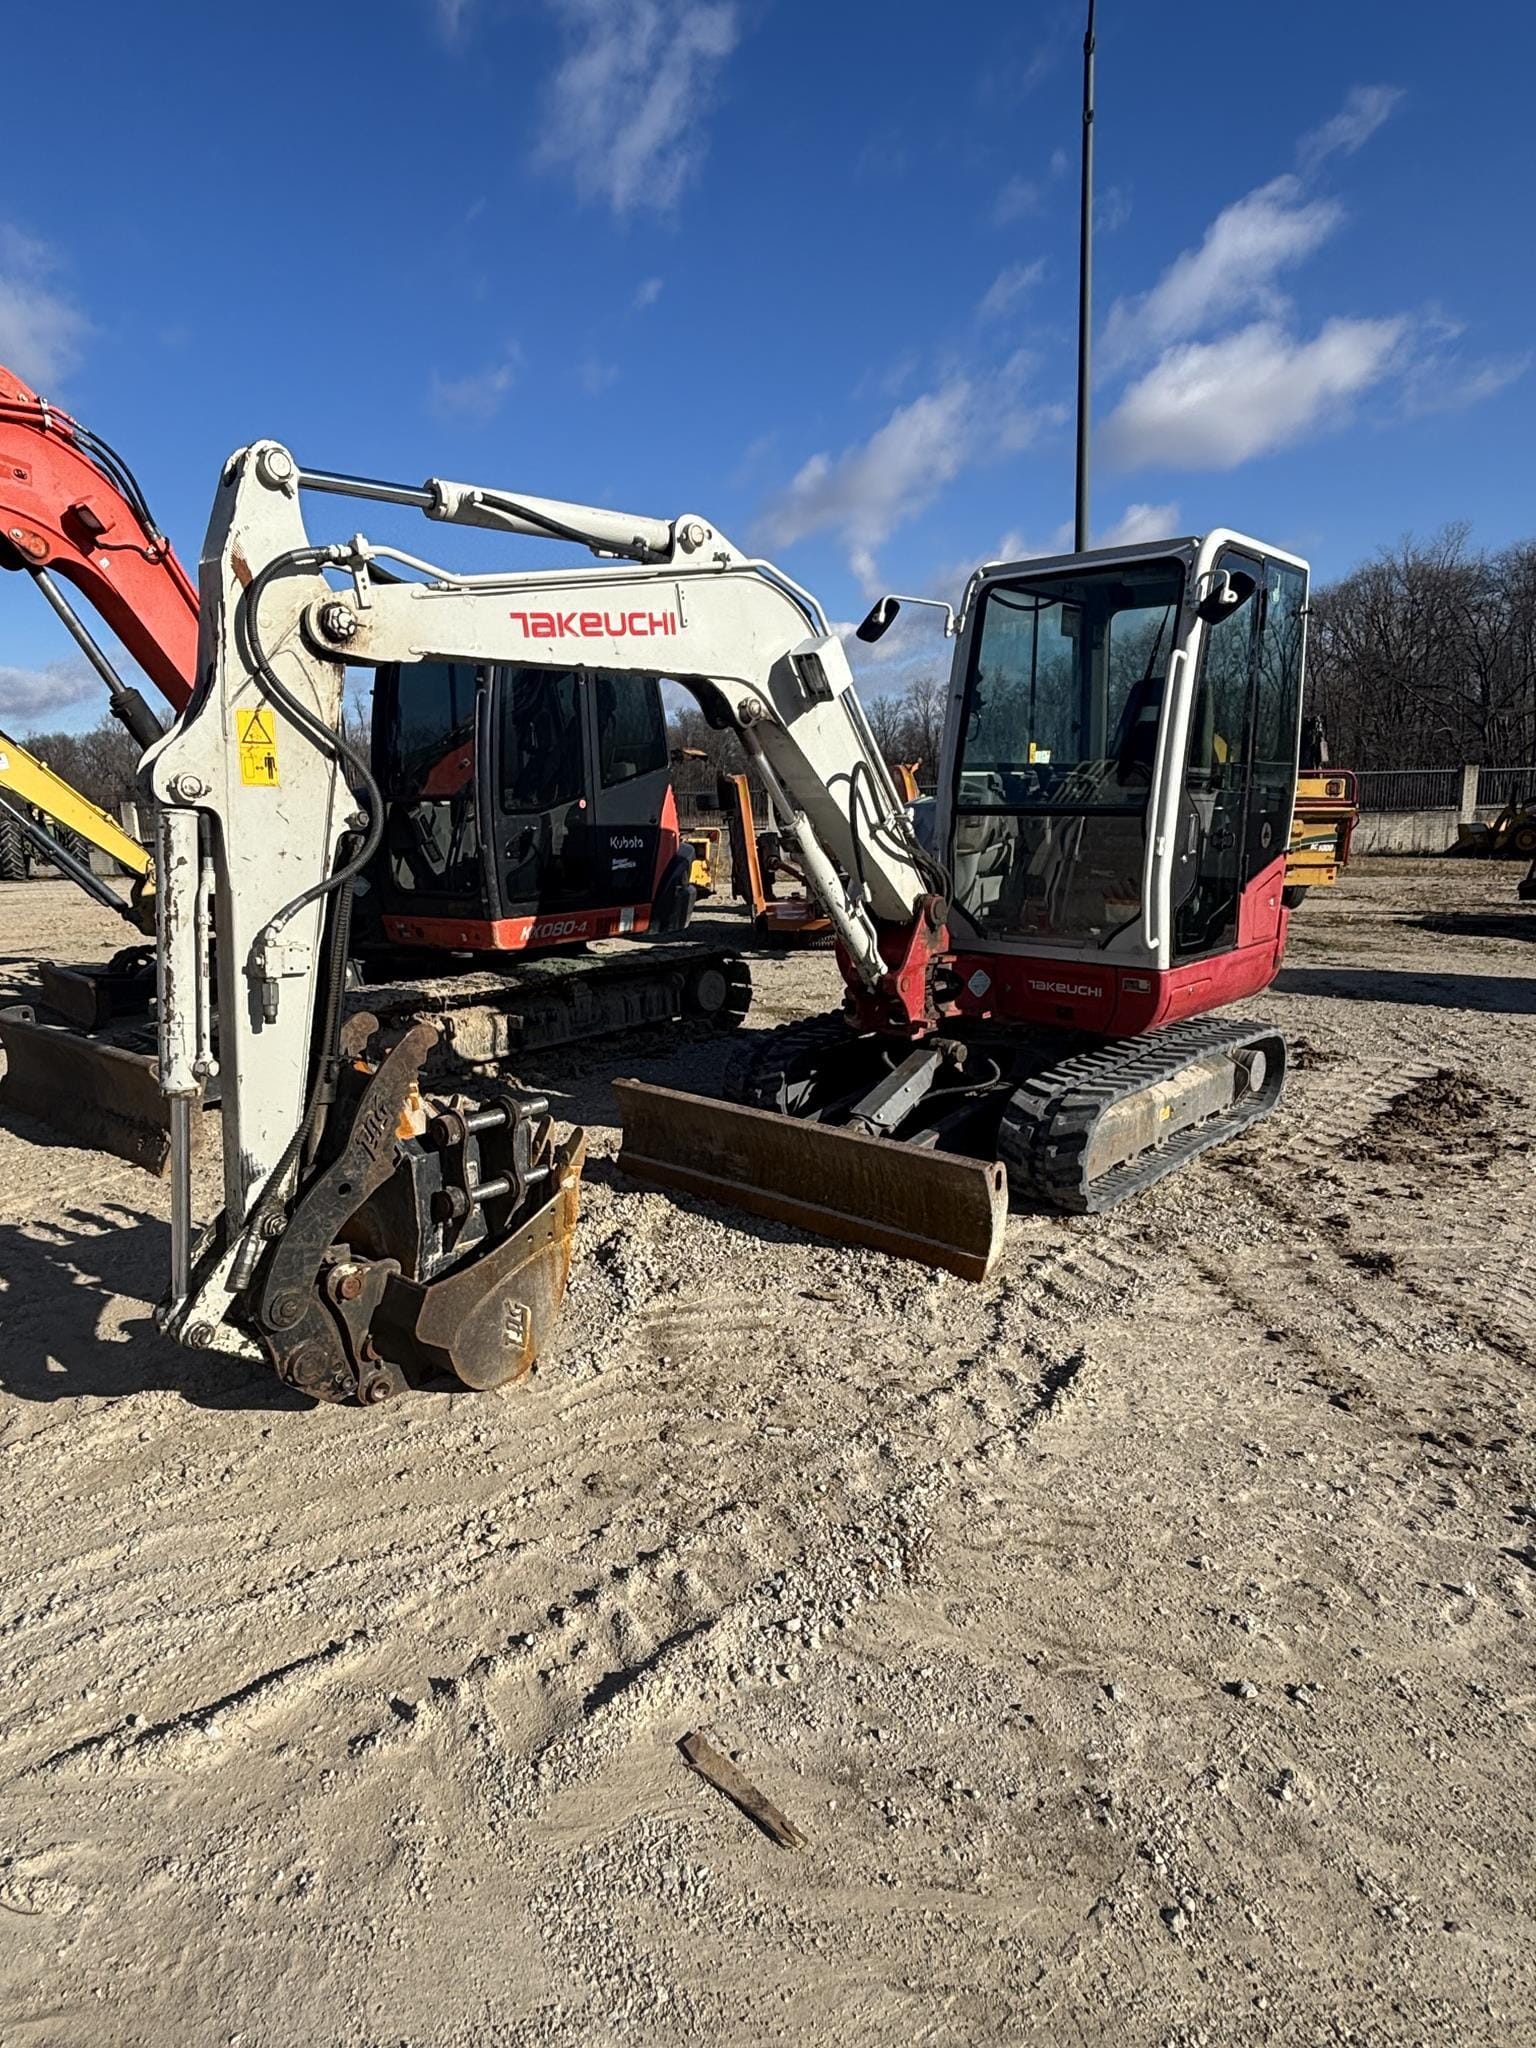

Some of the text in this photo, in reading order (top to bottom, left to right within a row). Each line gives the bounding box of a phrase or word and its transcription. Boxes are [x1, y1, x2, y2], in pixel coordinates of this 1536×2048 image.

[509, 612, 677, 638] TAKEUCHI
[610, 835, 644, 849] Kubota
[520, 920, 588, 941] KX080-4
[1028, 980, 1102, 998] TAKEUCHI
